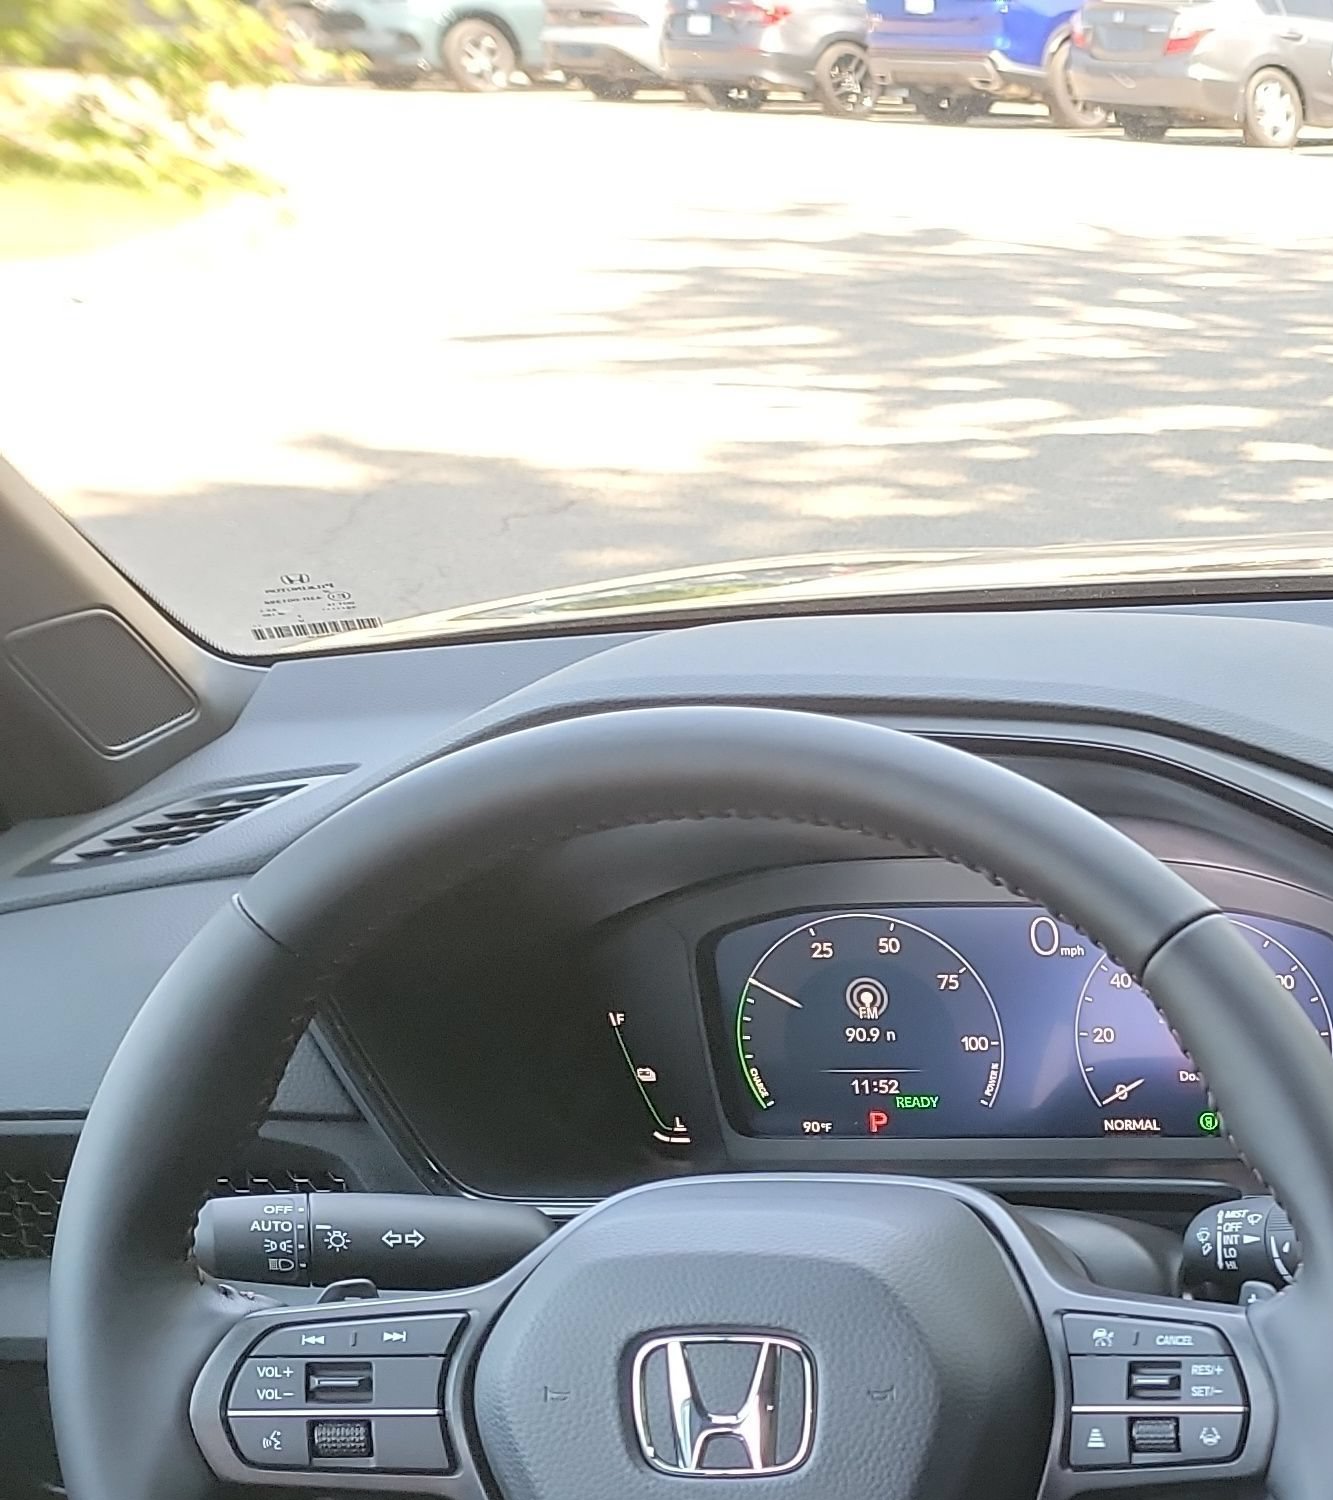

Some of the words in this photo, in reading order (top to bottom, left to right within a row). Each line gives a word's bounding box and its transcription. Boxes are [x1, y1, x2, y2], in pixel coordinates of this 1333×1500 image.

[1030, 916, 1059, 956] 0
[811, 942, 834, 958] 25
[878, 938, 901, 953] 50
[1060, 945, 1085, 957] mph
[936, 974, 960, 990] 75
[1110, 972, 1132, 989] 40
[858, 1006, 879, 1019] FM
[616, 1013, 625, 1026] F
[845, 1027, 880, 1042] 90.9
[886, 1030, 896, 1041] n
[1093, 1027, 1115, 1043] 20
[961, 1036, 989, 1051] 100
[851, 1079, 900, 1095] 11:52
[896, 1096, 939, 1109] READY
[869, 1111, 889, 1133] P
[1103, 1119, 1160, 1132] NORMAL
[263, 1205, 294, 1214] OFF
[1224, 1209, 1249, 1219] MIST
[250, 1220, 293, 1232] AUTO
[1223, 1222, 1243, 1233] OFF
[1223, 1234, 1240, 1245] INT
[1223, 1247, 1237, 1258] LO
[1156, 1335, 1195, 1346] CANCEL
